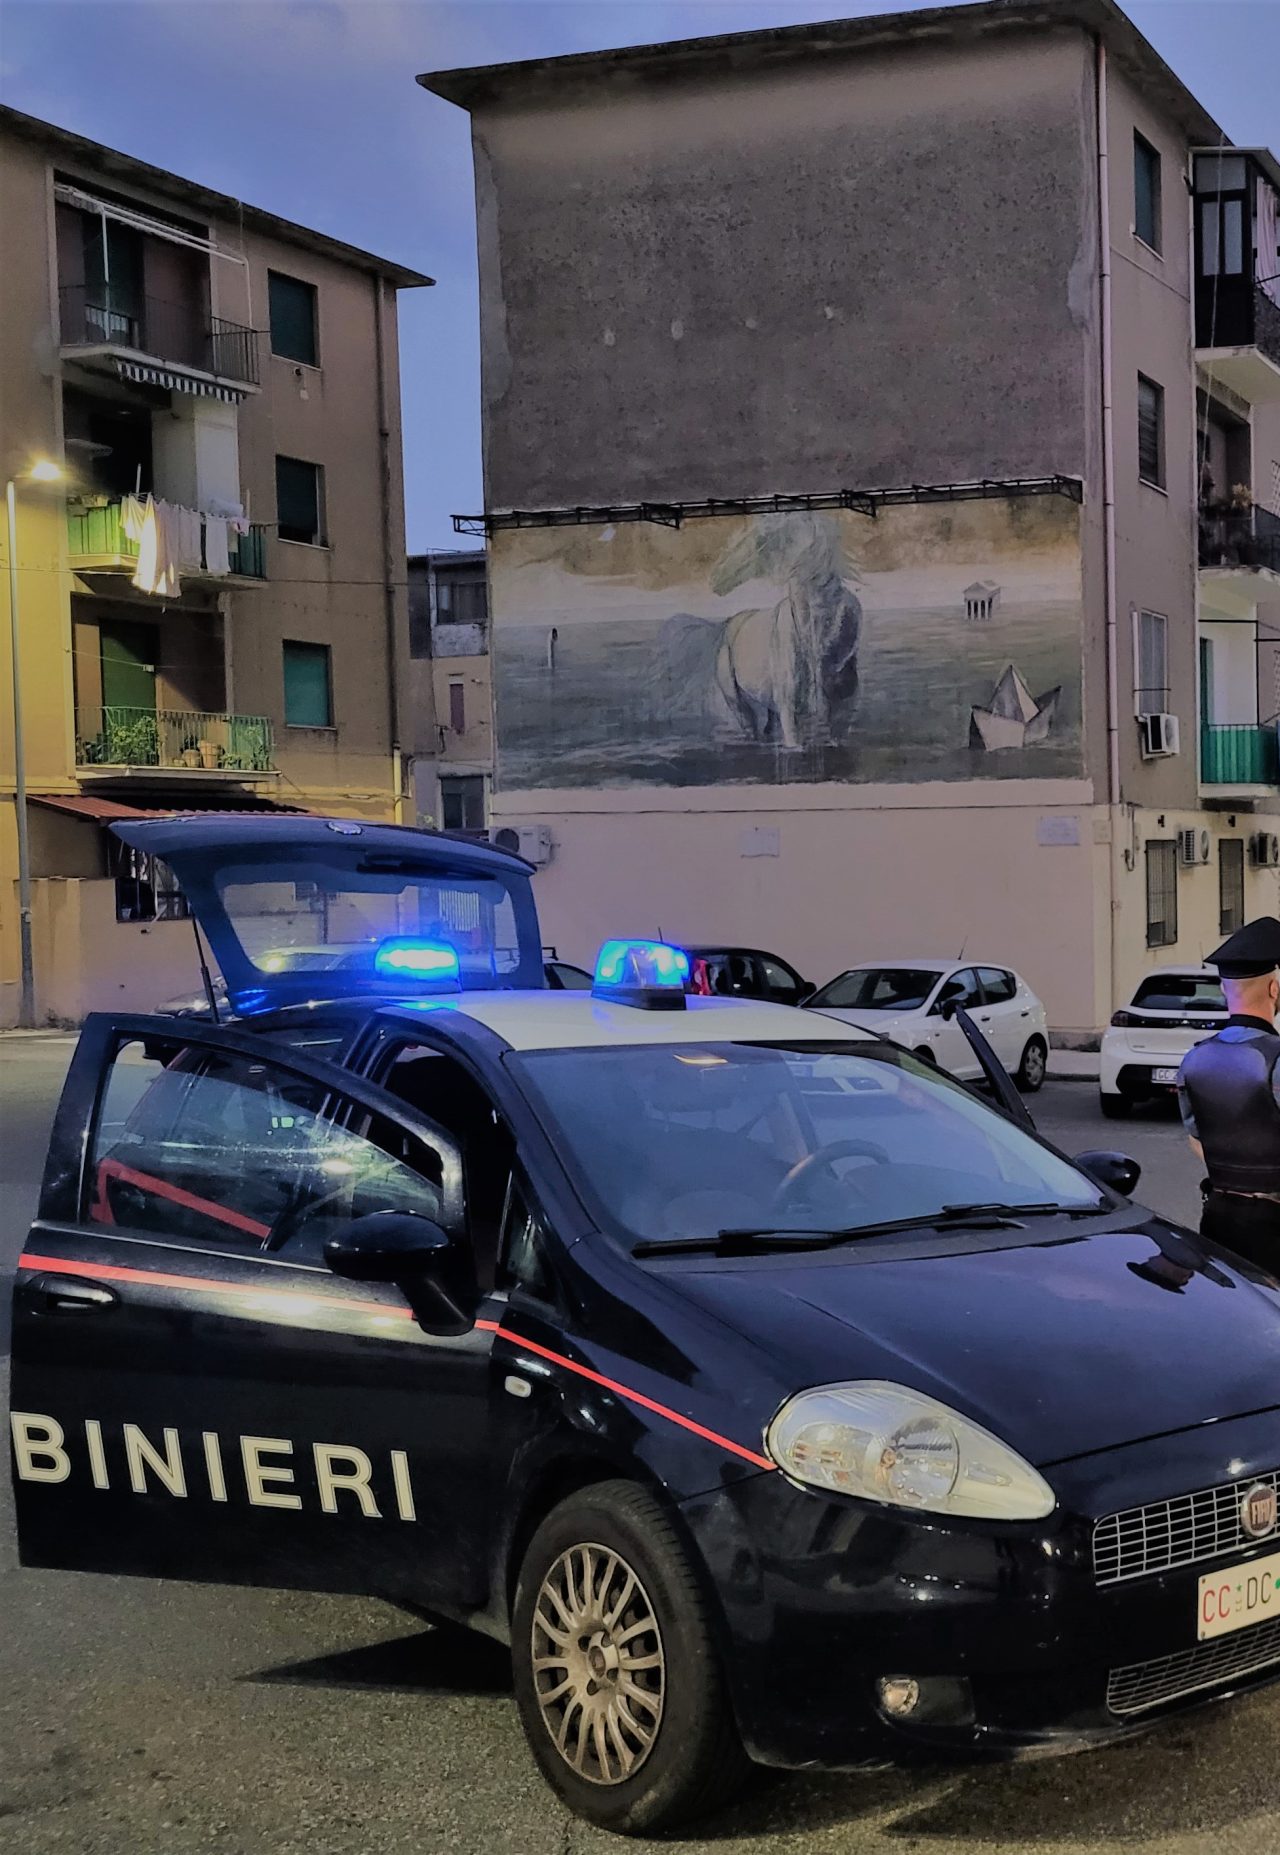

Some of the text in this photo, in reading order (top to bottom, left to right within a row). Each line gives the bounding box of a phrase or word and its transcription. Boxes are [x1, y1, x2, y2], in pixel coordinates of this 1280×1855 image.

[11, 1411, 417, 1522] BINIERI
[1203, 1585, 1230, 1623] CC
[1247, 1572, 1271, 1610] DC
